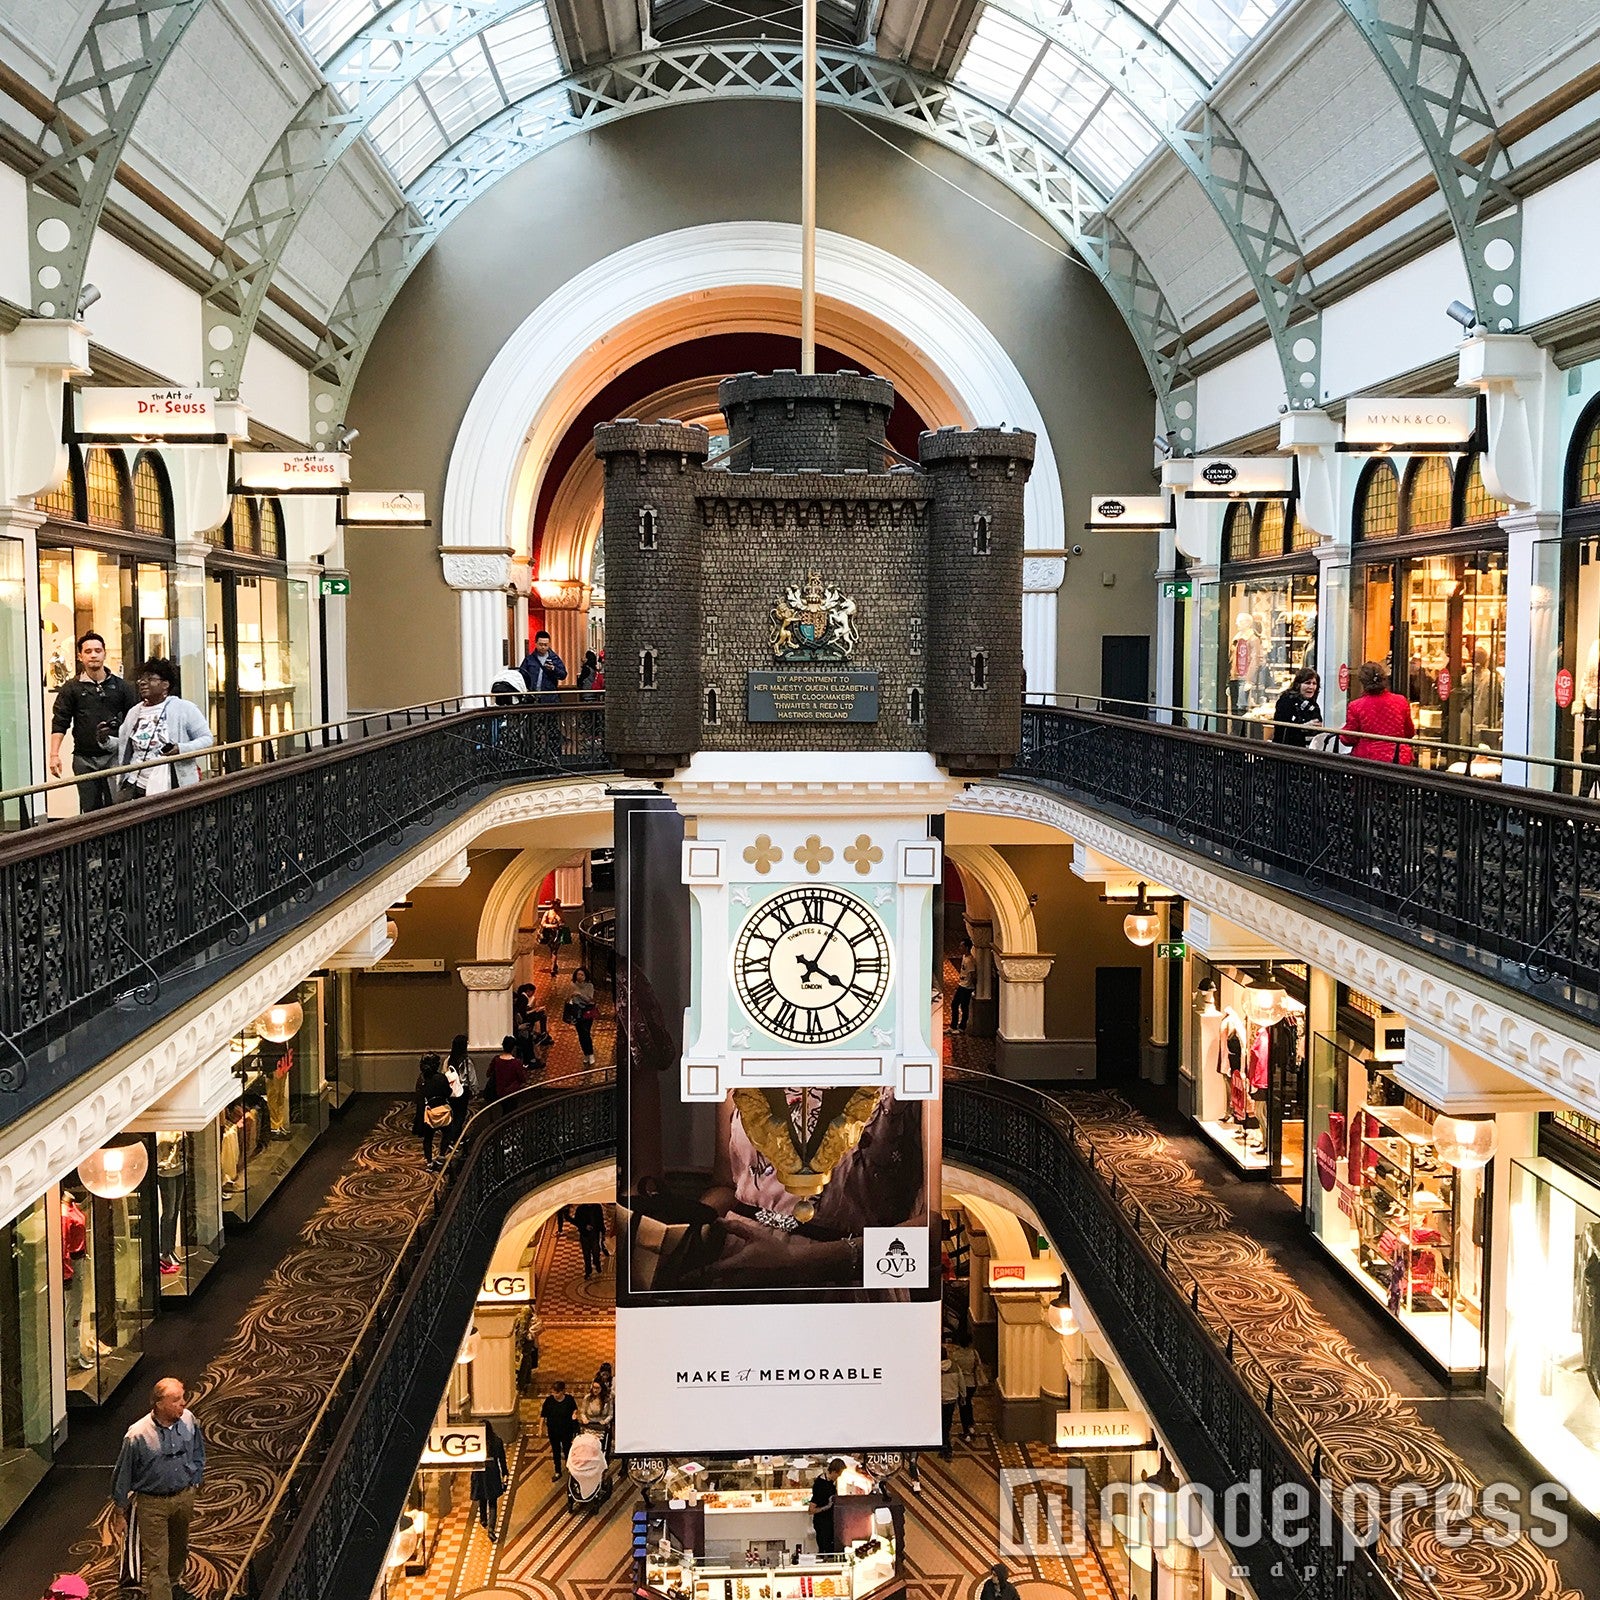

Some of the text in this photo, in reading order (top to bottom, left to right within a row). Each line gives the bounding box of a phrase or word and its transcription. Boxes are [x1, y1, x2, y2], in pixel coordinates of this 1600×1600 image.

[166, 391, 181, 399] Art
[137, 400, 206, 413] Dr. Seuss
[1367, 414, 1451, 424] MYNK&CO.
[283, 462, 335, 472] Dr. Seuss
[753, 684, 768, 692] HER
[770, 684, 803, 692] MAJESTY
[805, 684, 829, 692] QUEEN
[830, 684, 868, 692] ELIZABETH
[801, 693, 855, 701] CLOCKMAKERS
[778, 711, 848, 719] HASTINGS ENGLAND
[801, 899, 824, 923] XII
[787, 928, 815, 942] THWAITES
[876, 1257, 917, 1278] QVB
[995, 1267, 1024, 1279] CAMPER
[482, 1276, 526, 1296] UGG
[676, 1367, 883, 1383] MAKE it MEMORABLE
[1092, 1424, 1130, 1436] BALE
[427, 1433, 481, 1457] UGG
[630, 1460, 664, 1470] ZUMBO
[867, 1454, 900, 1464] ZUMBO
